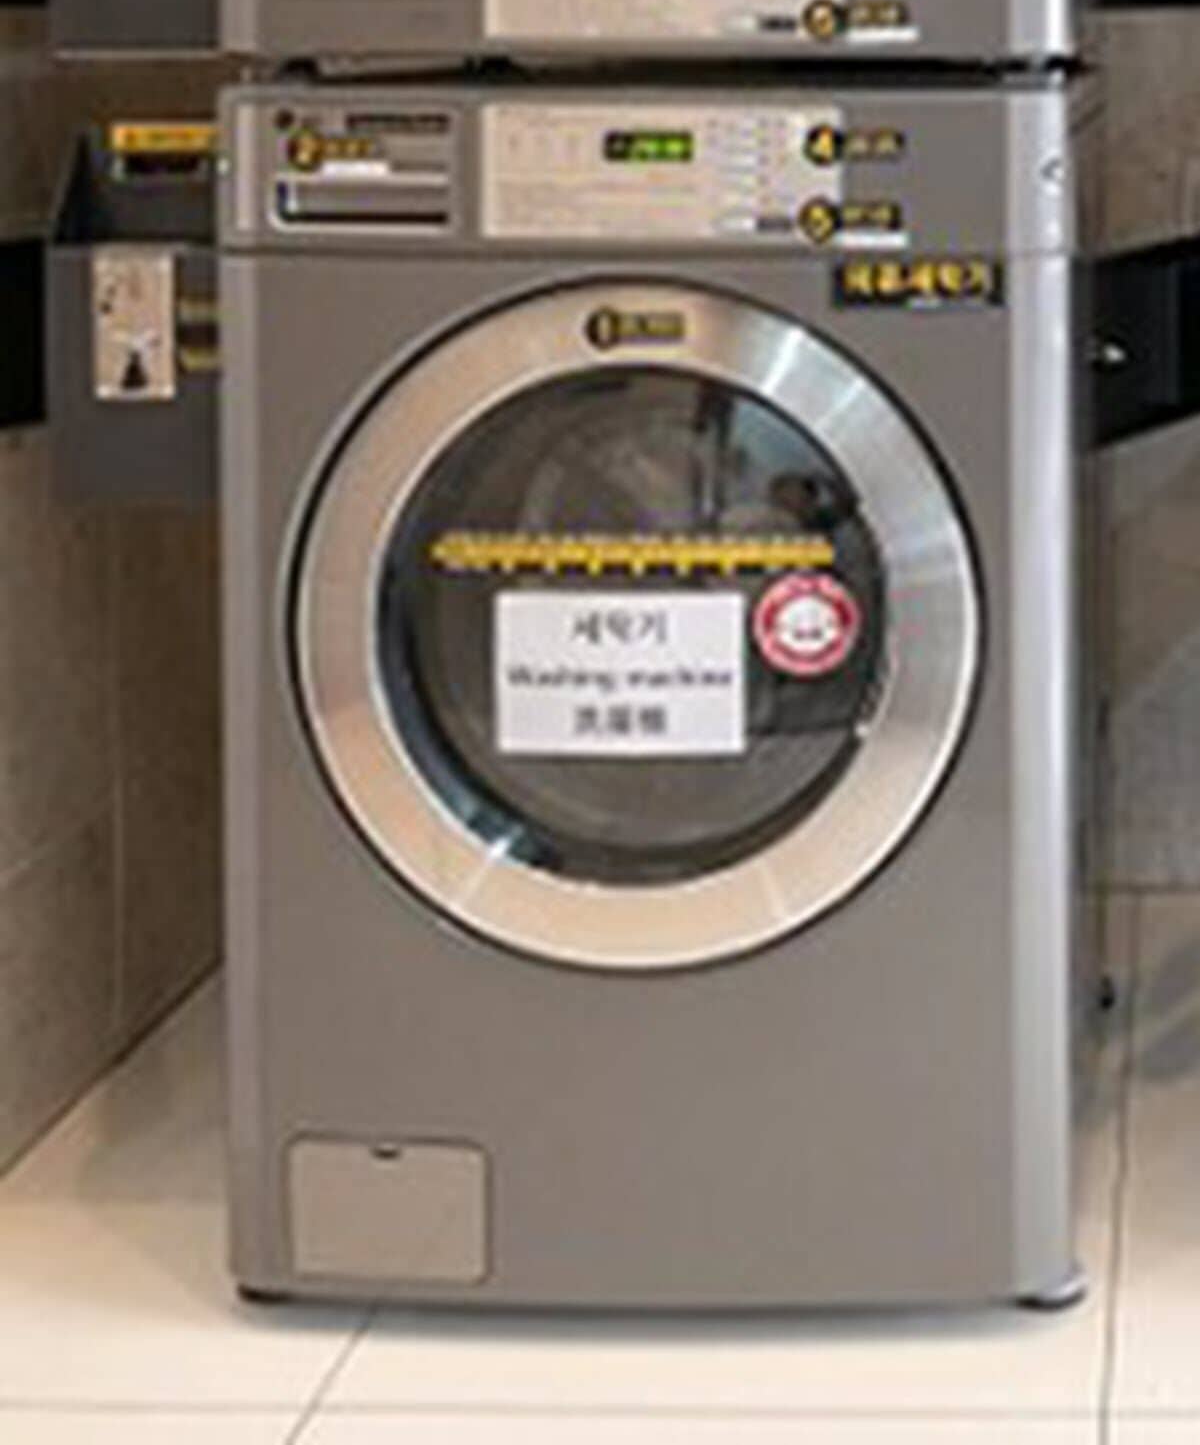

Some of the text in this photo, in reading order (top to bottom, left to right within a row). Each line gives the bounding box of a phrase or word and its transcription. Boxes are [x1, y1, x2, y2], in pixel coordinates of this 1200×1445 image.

[570, 611, 668, 643] 세탁기
[508, 665, 733, 696] Washing machine
